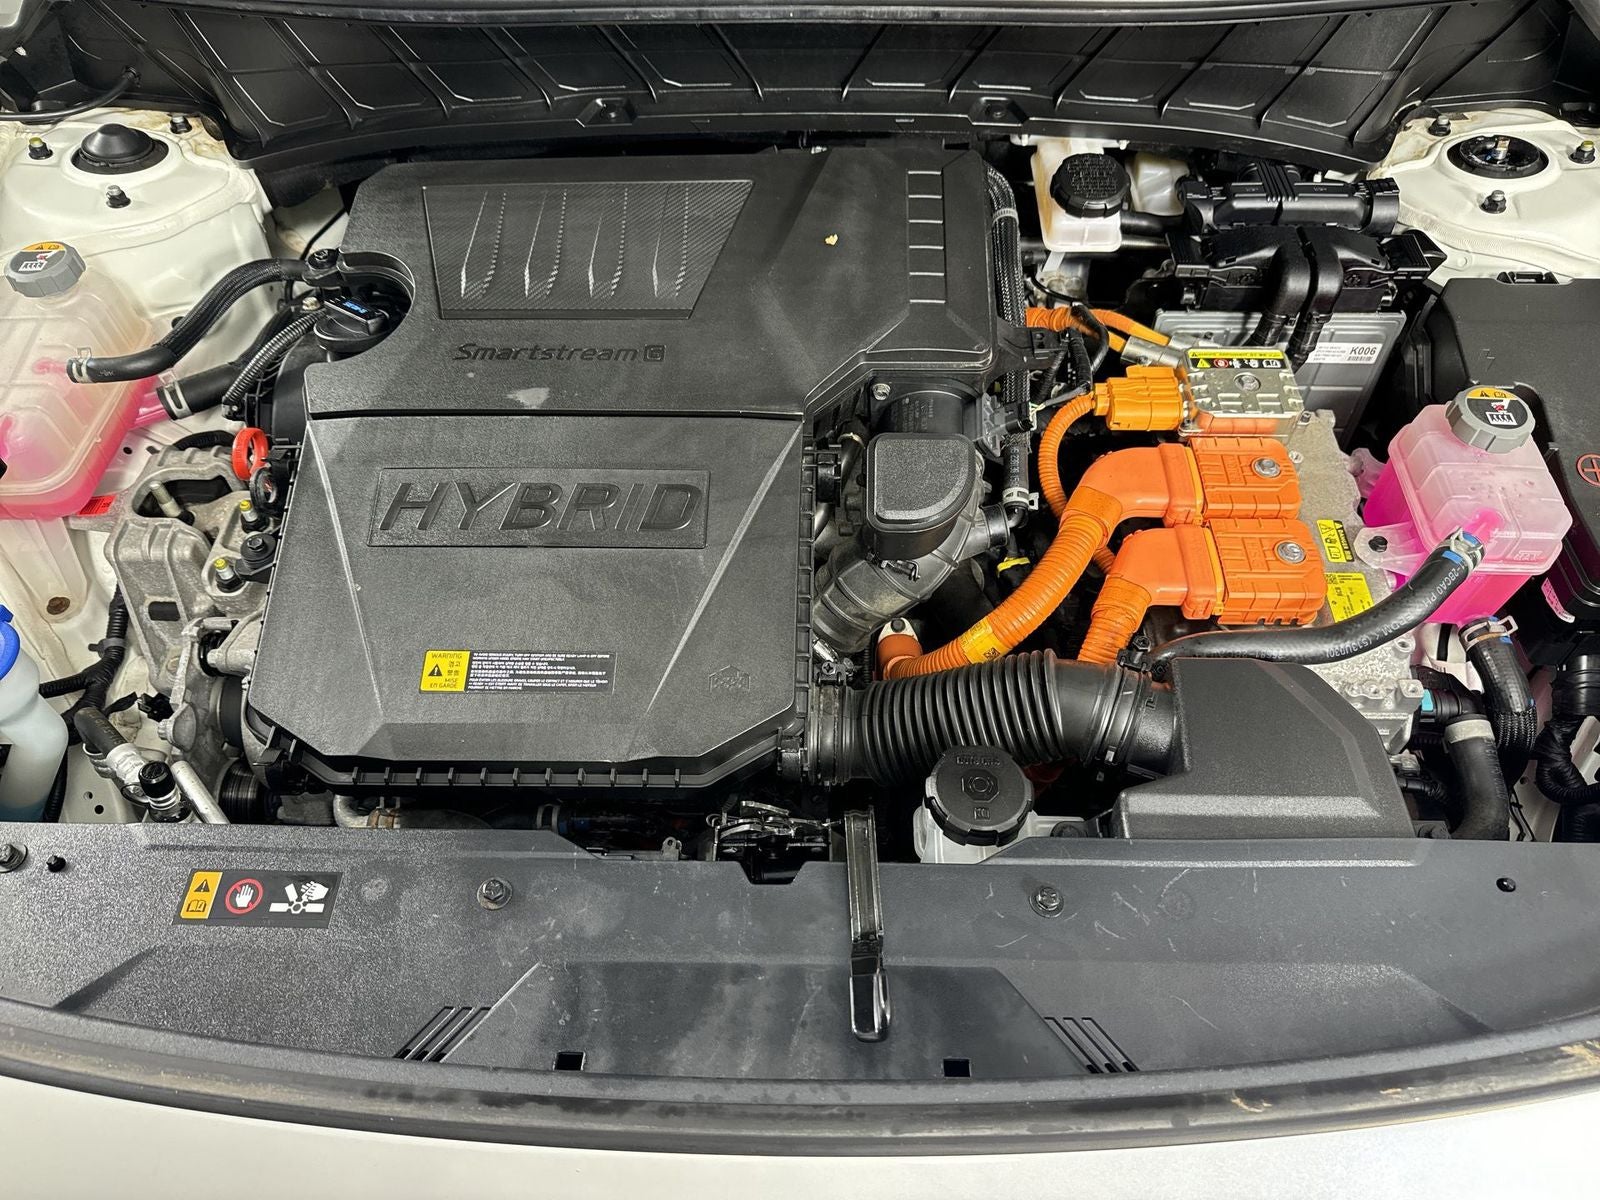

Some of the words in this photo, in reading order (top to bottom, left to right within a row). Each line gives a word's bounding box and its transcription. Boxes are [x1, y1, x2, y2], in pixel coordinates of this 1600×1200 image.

[452, 343, 638, 361] Smartstream
[1350, 346, 1377, 356] K006
[379, 482, 703, 532] HYBRID
